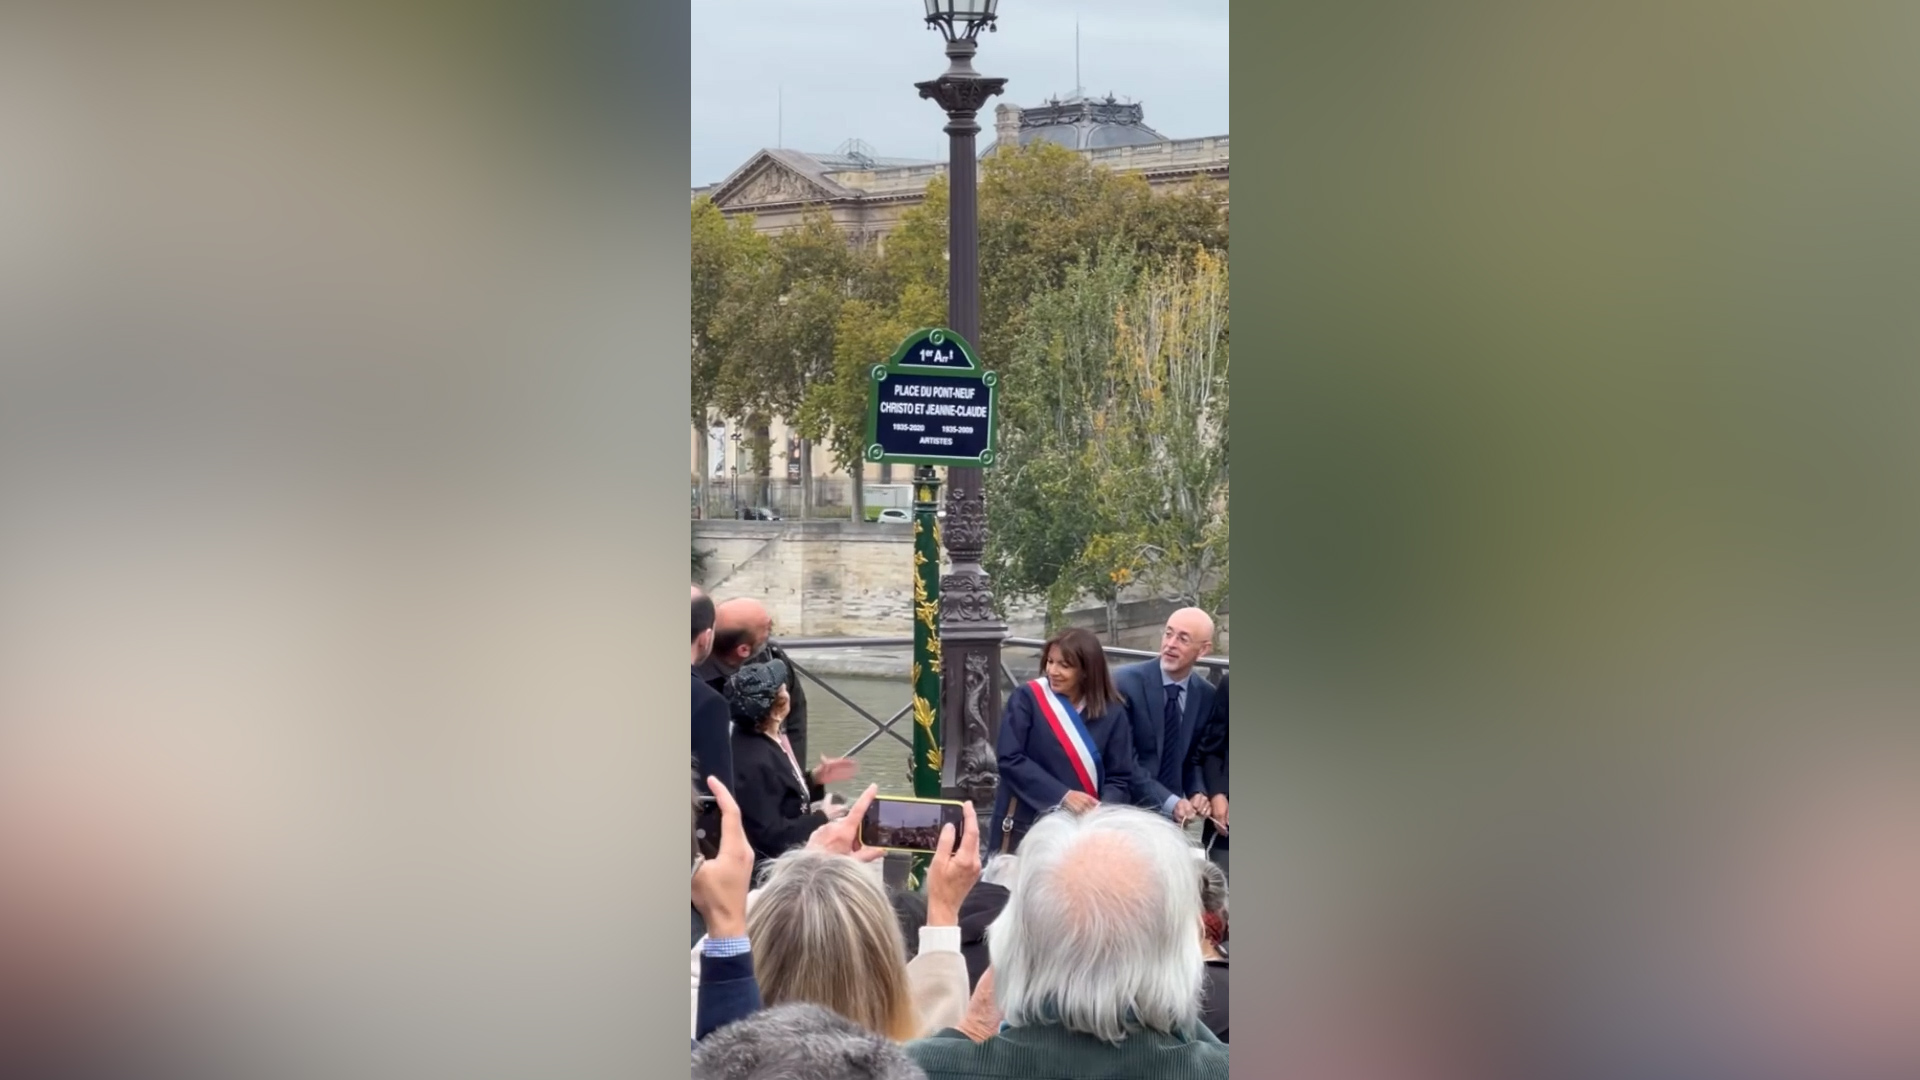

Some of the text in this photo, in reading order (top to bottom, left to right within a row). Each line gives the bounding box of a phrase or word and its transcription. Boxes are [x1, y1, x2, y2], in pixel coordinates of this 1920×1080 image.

[919, 349, 934, 362] 1er
[894, 384, 975, 399] PLACE DU PONT-NEUF
[880, 401, 987, 418] CHRISTO ET JEANNE-CLAUDE
[893, 423, 974, 434] 1935-2020 1935-2009
[919, 436, 953, 446] ARTISTES
